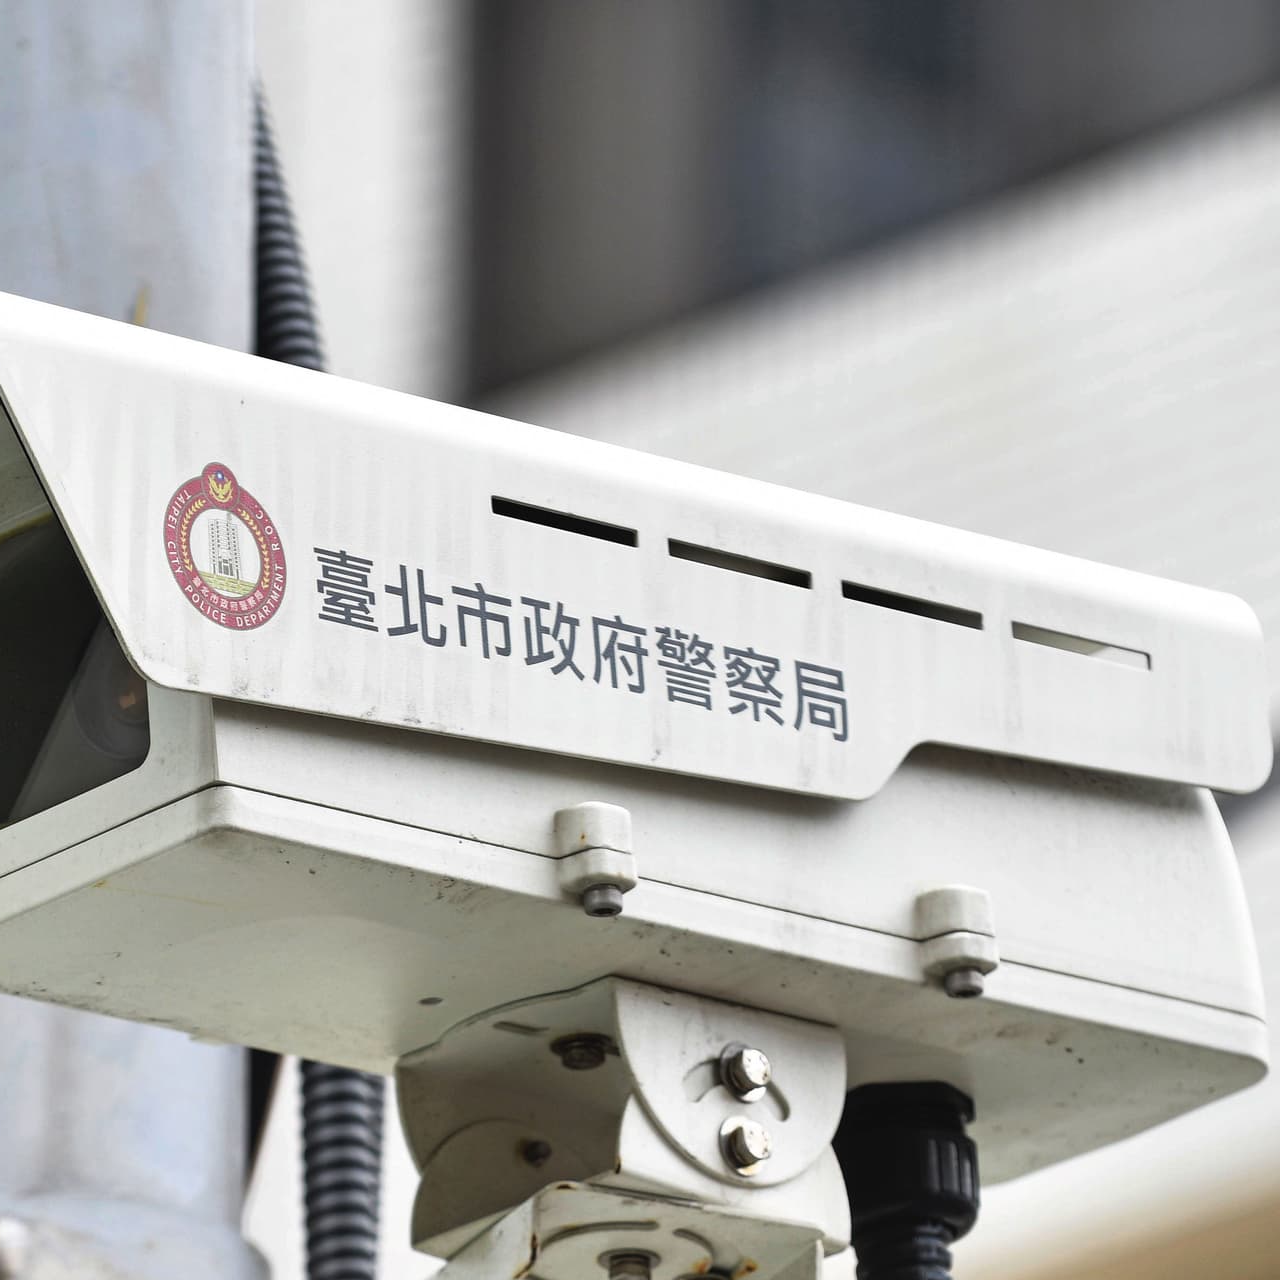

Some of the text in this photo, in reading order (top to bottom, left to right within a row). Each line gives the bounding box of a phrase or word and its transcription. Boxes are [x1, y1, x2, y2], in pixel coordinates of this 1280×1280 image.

[167, 490, 192, 530] TAIPEI
[167, 541, 184, 574] CITY
[184, 585, 228, 625] POLICE
[236, 564, 284, 628] DEPARTMENT
[312, 547, 849, 742] 臺北市政府警察局
